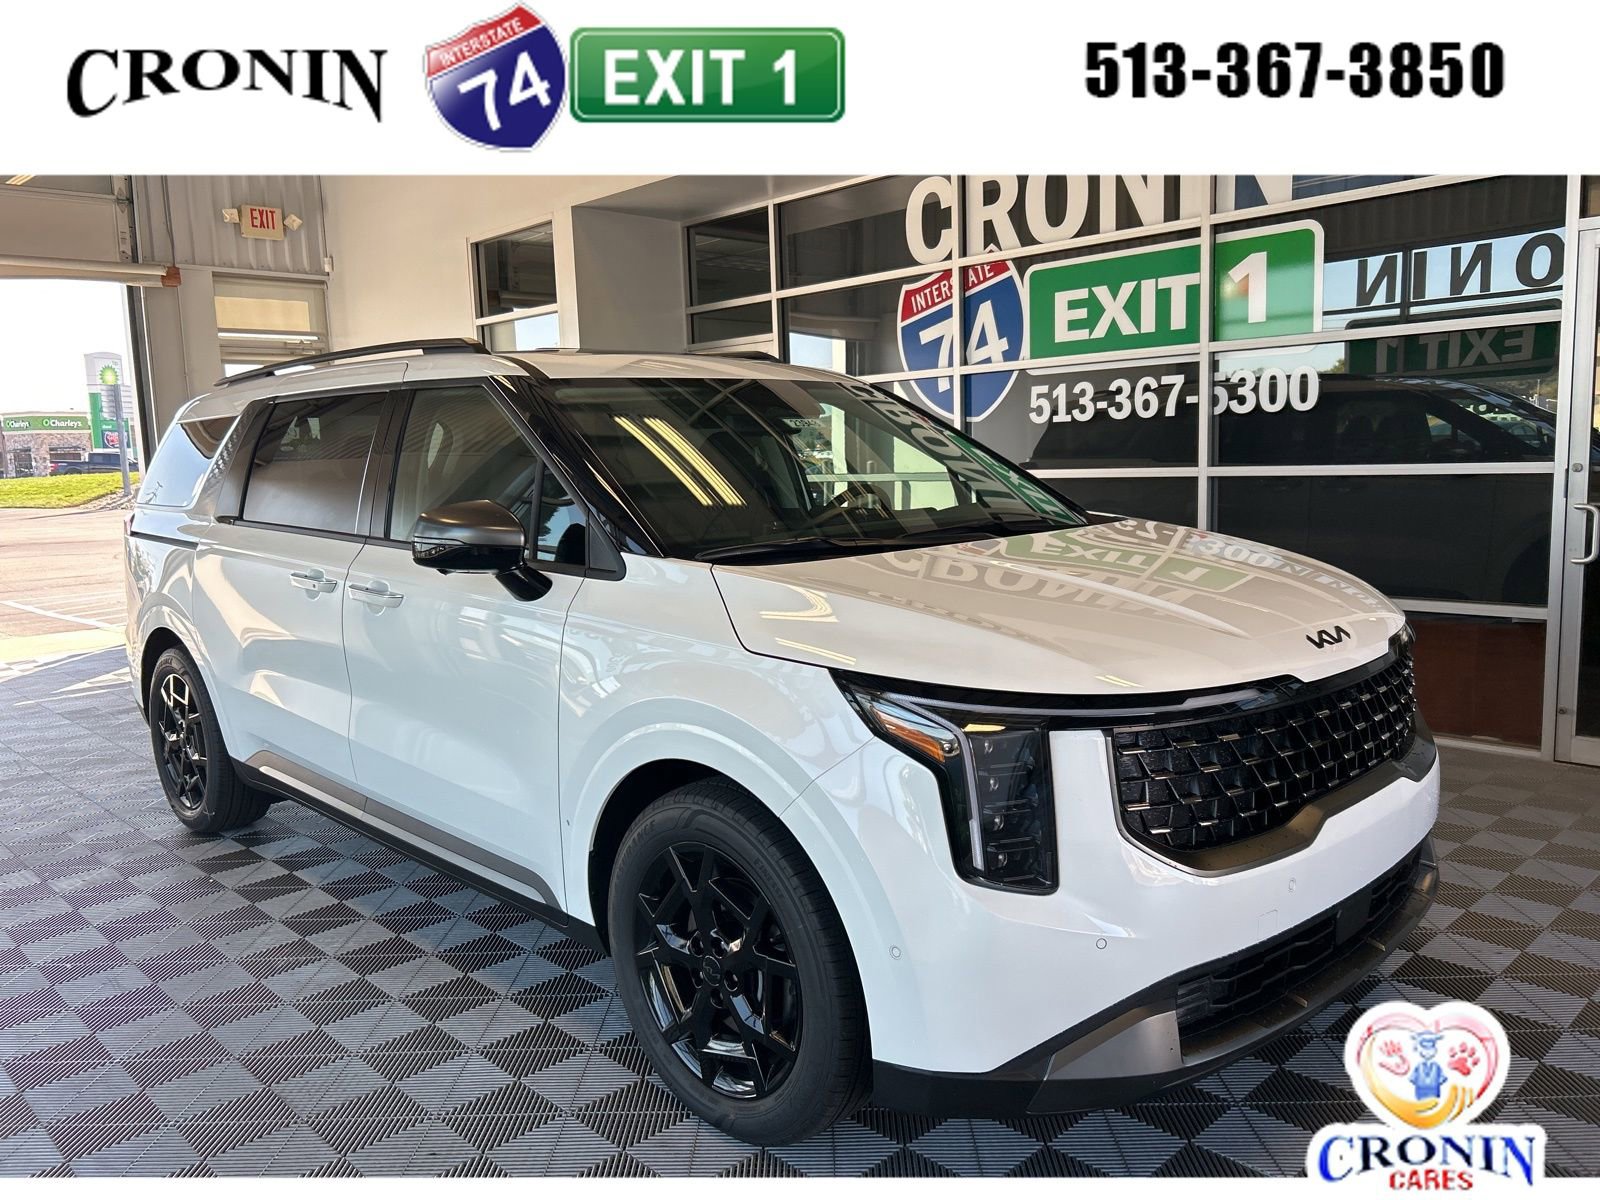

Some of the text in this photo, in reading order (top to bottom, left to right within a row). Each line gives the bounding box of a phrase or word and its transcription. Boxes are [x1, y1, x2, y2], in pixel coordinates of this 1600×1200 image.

[249, 207, 276, 230] EXIT
[1054, 251, 1268, 343] EXIT 1
[918, 300, 1009, 393] 74
[50, 419, 82, 429] Charleys
